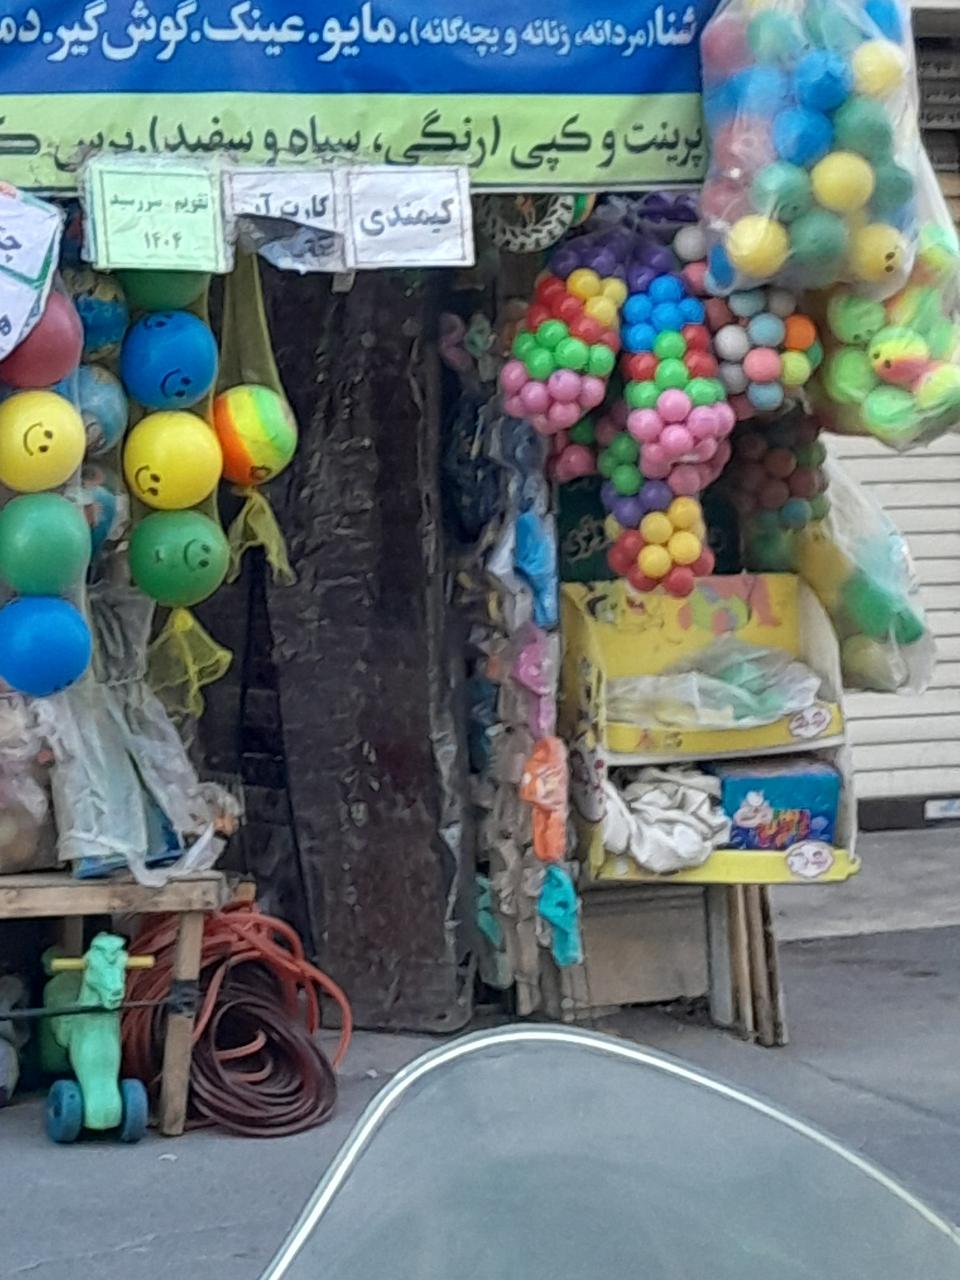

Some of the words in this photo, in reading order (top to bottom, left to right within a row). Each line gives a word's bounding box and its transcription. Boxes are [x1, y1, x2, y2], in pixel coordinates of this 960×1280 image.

[521, 18, 571, 56] زنانه
[510, 113, 592, 171] کپی
[622, 121, 703, 168] پرینت
[144, 231, 183, 251] ۱۴۰۴
